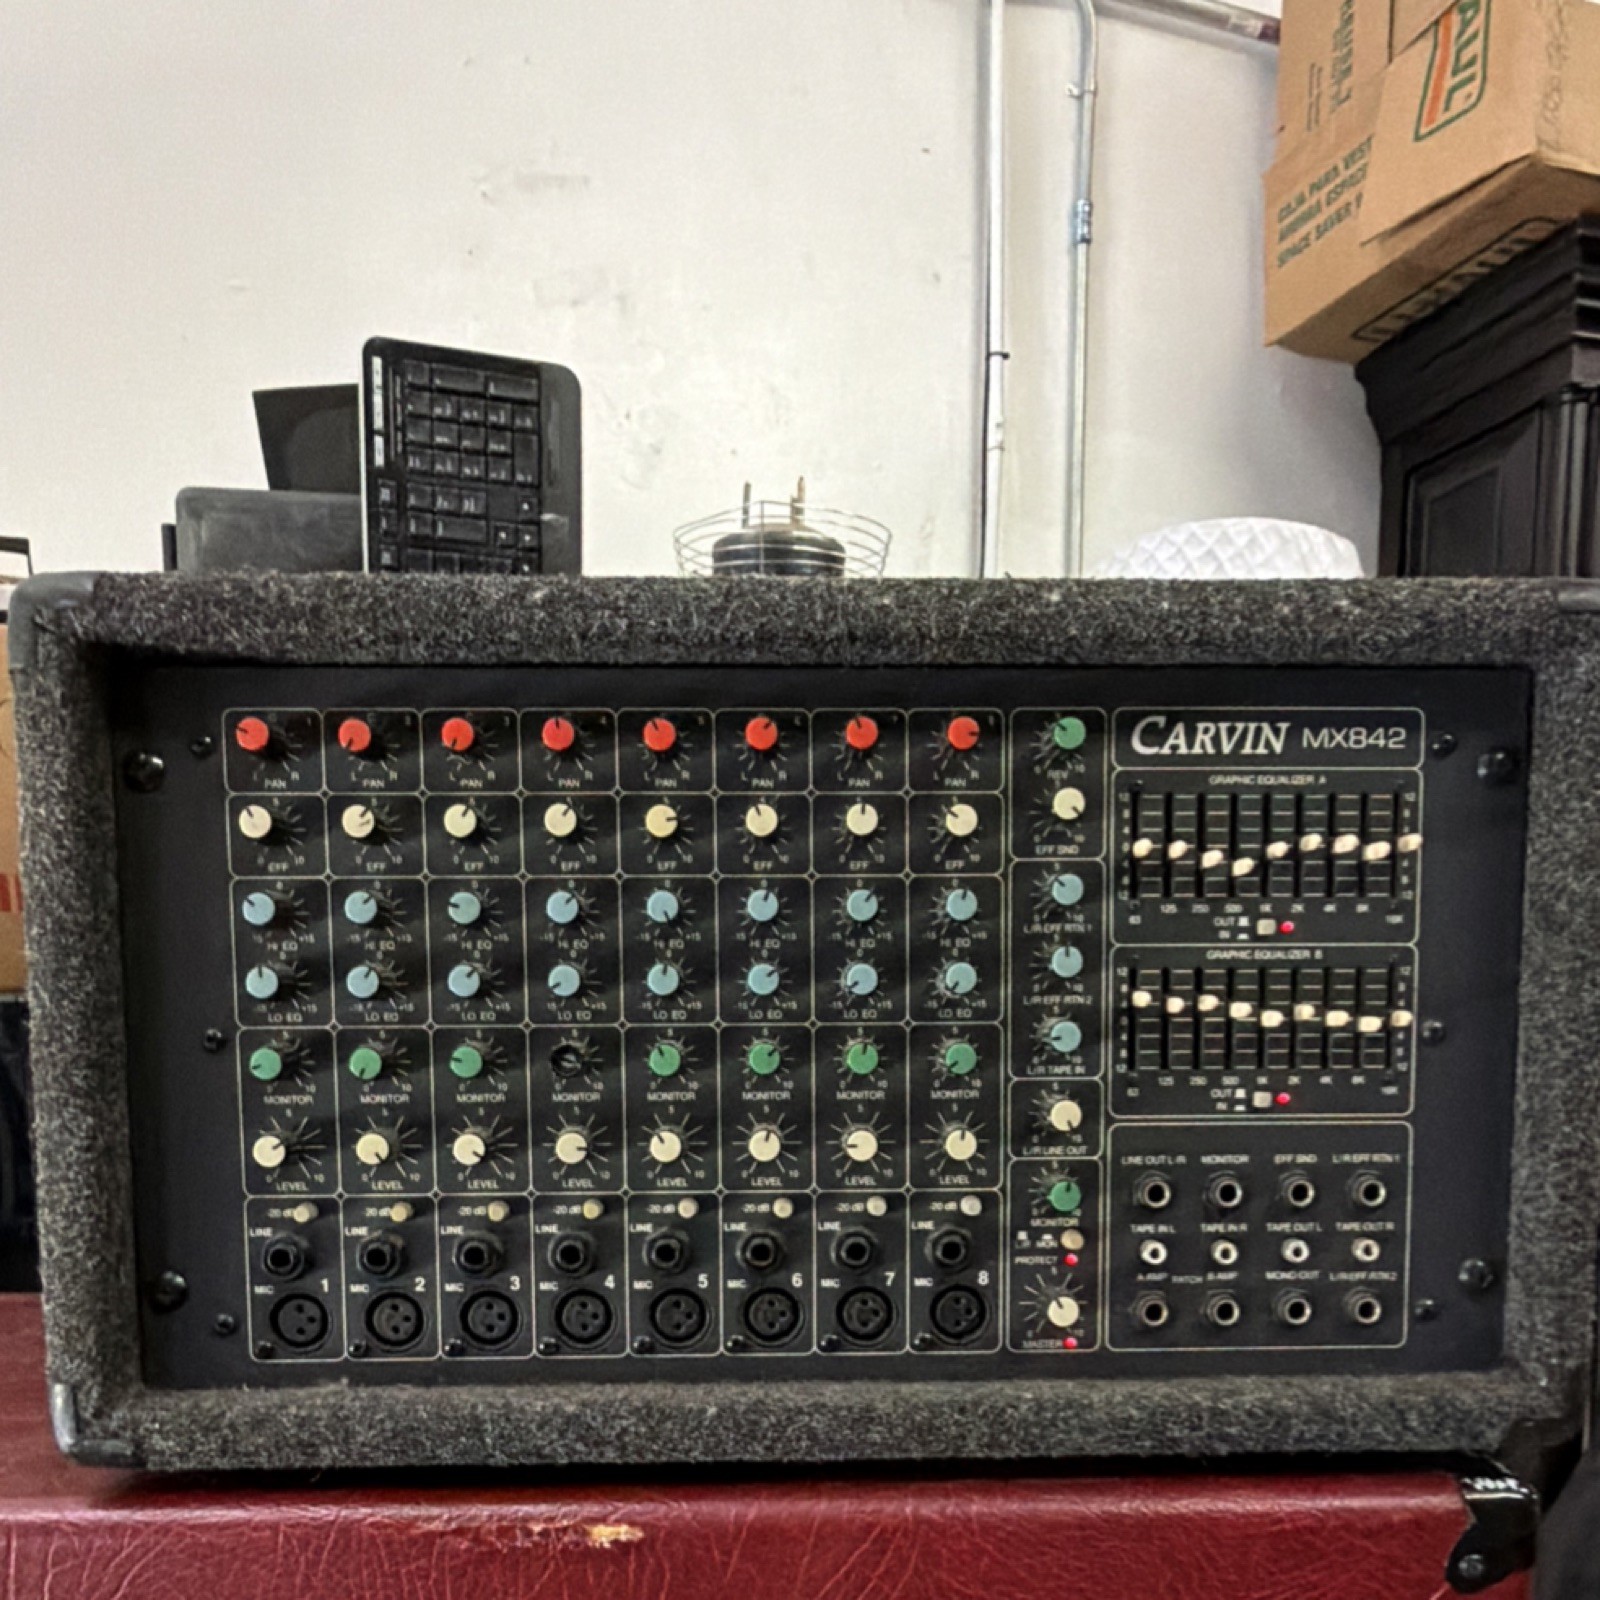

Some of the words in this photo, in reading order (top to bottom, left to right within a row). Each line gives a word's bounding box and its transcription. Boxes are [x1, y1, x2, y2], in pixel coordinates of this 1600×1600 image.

[1131, 715, 1291, 755] CARVIN
[1303, 727, 1406, 749] MX842
[265, 779, 286, 788] PAN
[363, 779, 384, 788] PAN
[460, 779, 482, 788] PAN
[558, 779, 579, 788] PAN
[655, 779, 677, 788] PAN
[753, 779, 773, 788] PAN
[849, 778, 870, 787] PAN
[945, 778, 966, 787] PAN
[1209, 775, 1255, 785] GRAPHIC
[1258, 775, 1314, 785] EQUALIZER
[1318, 775, 1327, 784] A
[268, 862, 288, 872] EFF
[366, 862, 386, 872] EFF
[464, 862, 483, 871] EFF
[561, 862, 581, 871] EFF
[657, 861, 677, 871] EFF
[754, 861, 773, 870] EFF
[850, 861, 869, 870] EFF
[946, 860, 965, 870] EFF
[1214, 917, 1235, 926] OUT
[282, 941, 298, 950] EQ
[380, 941, 395, 950] EQ
[476, 940, 492, 949] EQ
[573, 940, 589, 949] EQ
[669, 939, 684, 948] EQ
[765, 939, 780, 948] EQ
[861, 939, 876, 948] EQ
[956, 938, 971, 947] EQ
[1207, 950, 1252, 960] GRAPHIC
[1255, 950, 1310, 960] EQUALIZER
[268, 1013, 284, 1022] LO
[287, 1013, 302, 1022] EQ
[365, 1013, 381, 1022] LO
[384, 1013, 399, 1022] EQ
[462, 1012, 478, 1021] LO
[481, 1012, 496, 1021] EQ
[558, 1011, 574, 1020] LO
[576, 1011, 591, 1020] EQ
[653, 1011, 669, 1019] LO
[672, 1011, 687, 1019] EQ
[750, 1010, 765, 1019] LO
[768, 1010, 782, 1019] EQ
[844, 1010, 860, 1019] LO
[862, 1010, 878, 1019] EQ
[939, 1009, 954, 1018] LO
[956, 1009, 972, 1018] EQ
[457, 1093, 506, 1102] MONITOR
[553, 1092, 600, 1102] MONITOR
[648, 1092, 696, 1101] MONITOR
[742, 1091, 790, 1100] MONITOR
[837, 1091, 885, 1100] MONITOR
[932, 1090, 979, 1099] MONITOR
[1211, 1089, 1231, 1098] OUT
[264, 1095, 314, 1104] MONITOR
[361, 1094, 409, 1103] MONITOR
[1201, 1154, 1249, 1164] MONITOR
[468, 1180, 499, 1189] LEVEL
[563, 1178, 594, 1188] LEVEL
[657, 1178, 688, 1187] LEVEL
[752, 1177, 782, 1186] LEVEL
[845, 1176, 876, 1186] LEVEL
[940, 1176, 970, 1185] LEVEL
[276, 1181, 308, 1191] LEVEL
[372, 1181, 402, 1190] LEVEL
[818, 1222, 841, 1231] LINE
[912, 1221, 934, 1230] LINE
[1031, 1218, 1079, 1226] MONITOR
[1336, 1222, 1359, 1231] TAPE
[1362, 1222, 1384, 1231] OUT
[345, 1227, 368, 1236] LINE
[441, 1226, 464, 1235] LINE
[536, 1224, 559, 1234] LINE
[630, 1223, 652, 1232] LINE
[724, 1222, 747, 1232] LINE
[1131, 1224, 1152, 1234] TAPE
[1201, 1223, 1223, 1233] TAPE
[1266, 1222, 1289, 1232] TAPE
[1291, 1222, 1312, 1232] OUT
[250, 1228, 272, 1237] LINE
[1015, 1256, 1058, 1265] PROTECT
[792, 1273, 802, 1287] 6
[884, 1272, 895, 1286] 7
[978, 1271, 989, 1285] 8
[1265, 1271, 1293, 1281] MONO
[321, 1278, 329, 1292] 1
[415, 1278, 426, 1291] 2
[509, 1276, 520, 1289] 3
[604, 1275, 615, 1288] 4
[634, 1280, 652, 1289] MIC
[698, 1274, 708, 1288] 5
[728, 1279, 746, 1288] MIC
[821, 1278, 840, 1288] MIC
[914, 1278, 933, 1287] MIC
[254, 1285, 274, 1294] MIC
[350, 1284, 369, 1293] MIC
[445, 1282, 464, 1292] MIC
[539, 1281, 558, 1291] MIC
